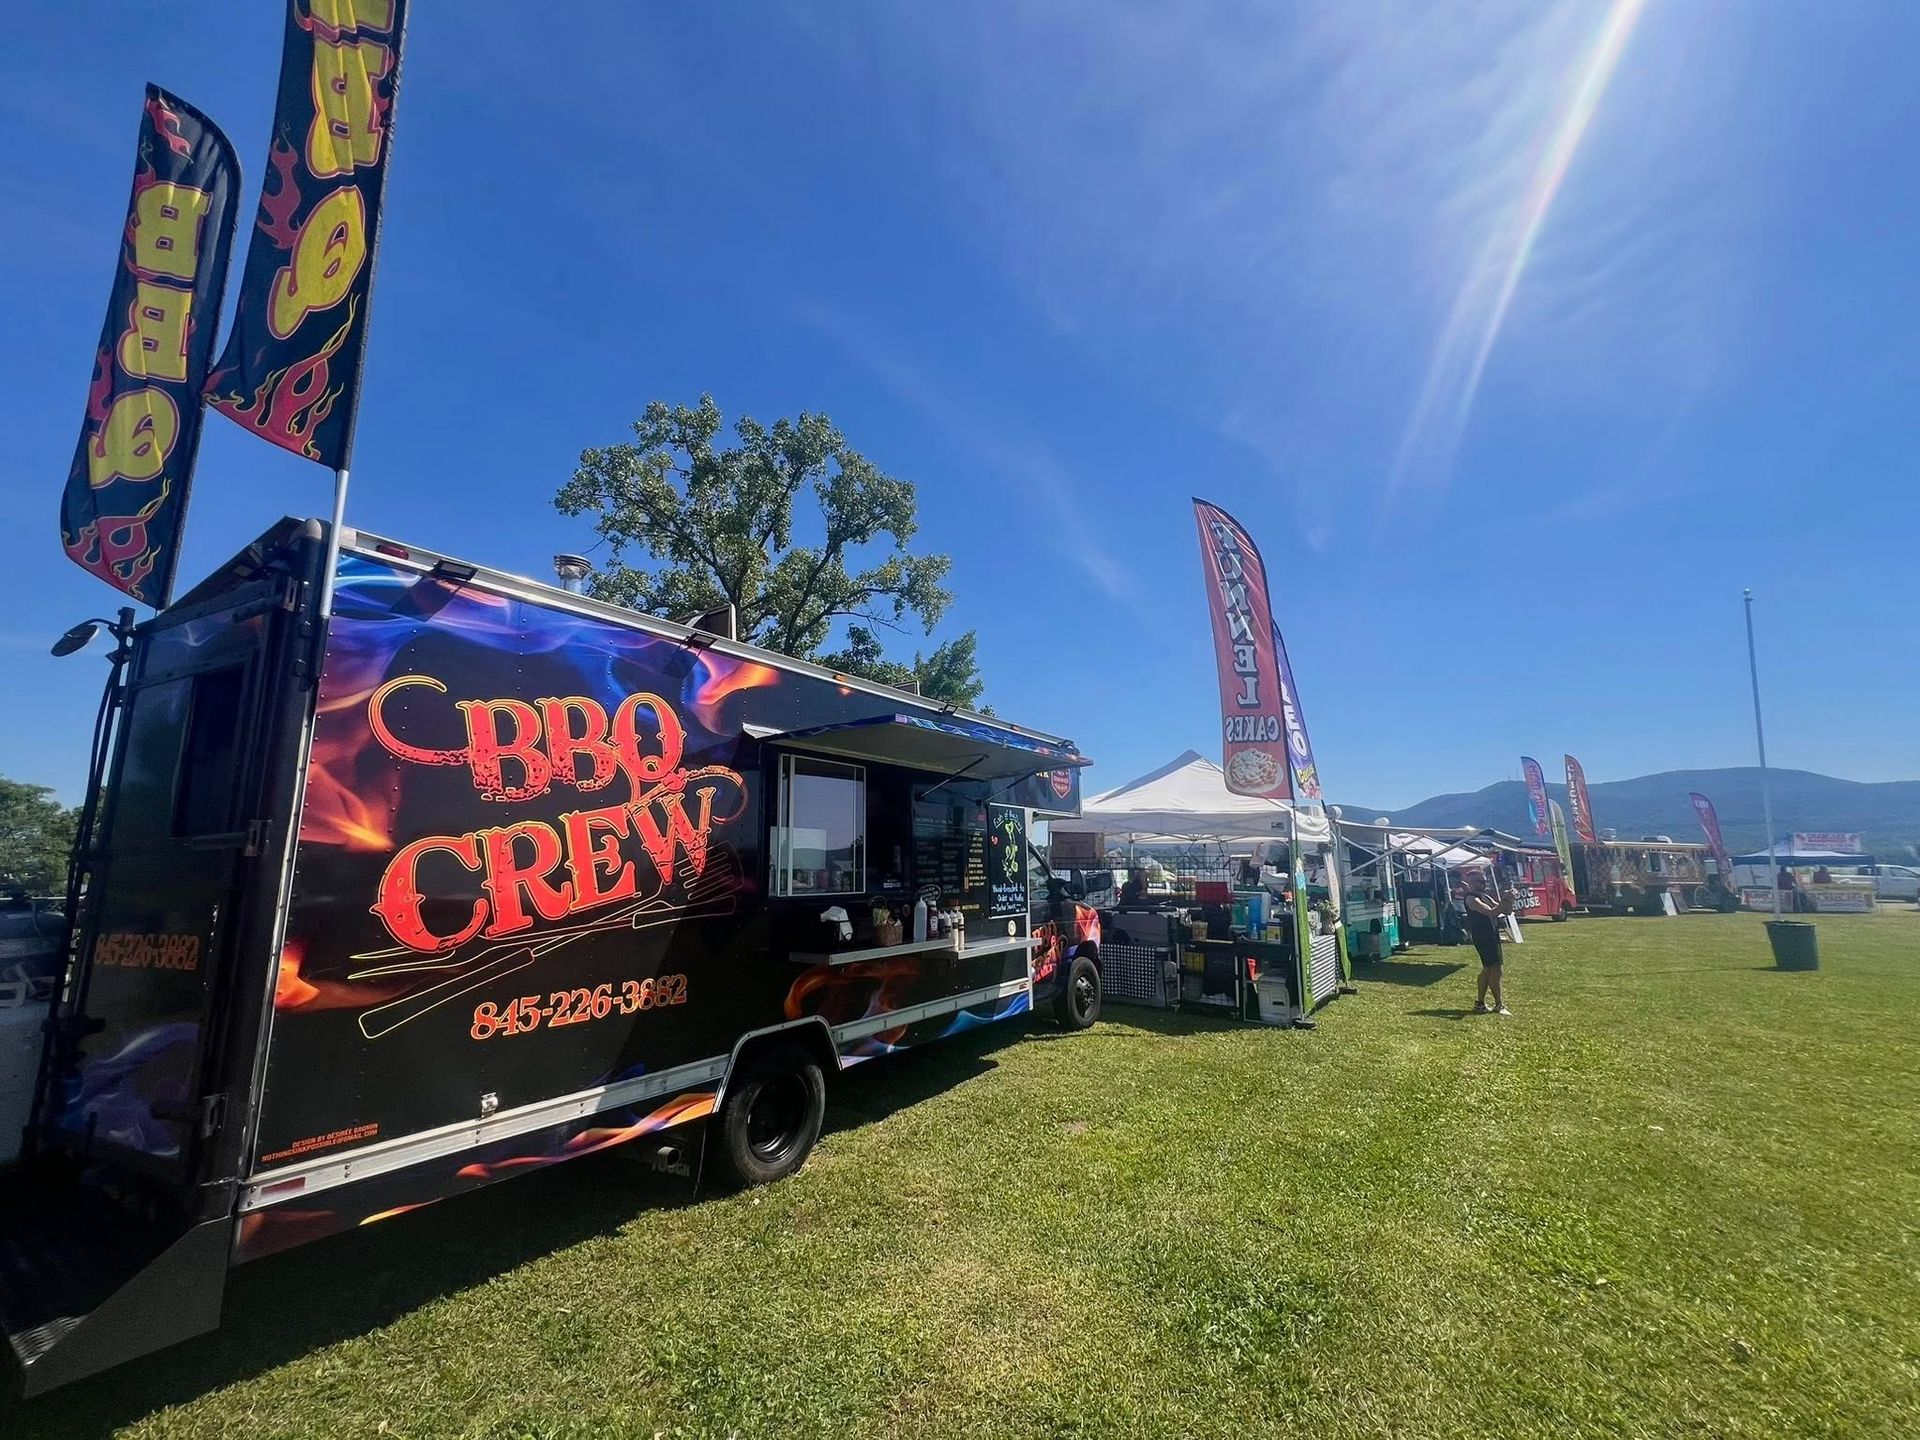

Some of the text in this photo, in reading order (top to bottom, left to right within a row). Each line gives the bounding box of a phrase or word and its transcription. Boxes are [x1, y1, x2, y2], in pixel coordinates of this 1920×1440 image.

[369, 675, 686, 803] BBQ
[369, 768, 735, 953] CREW
[470, 974, 688, 1041] 845-226-3882
